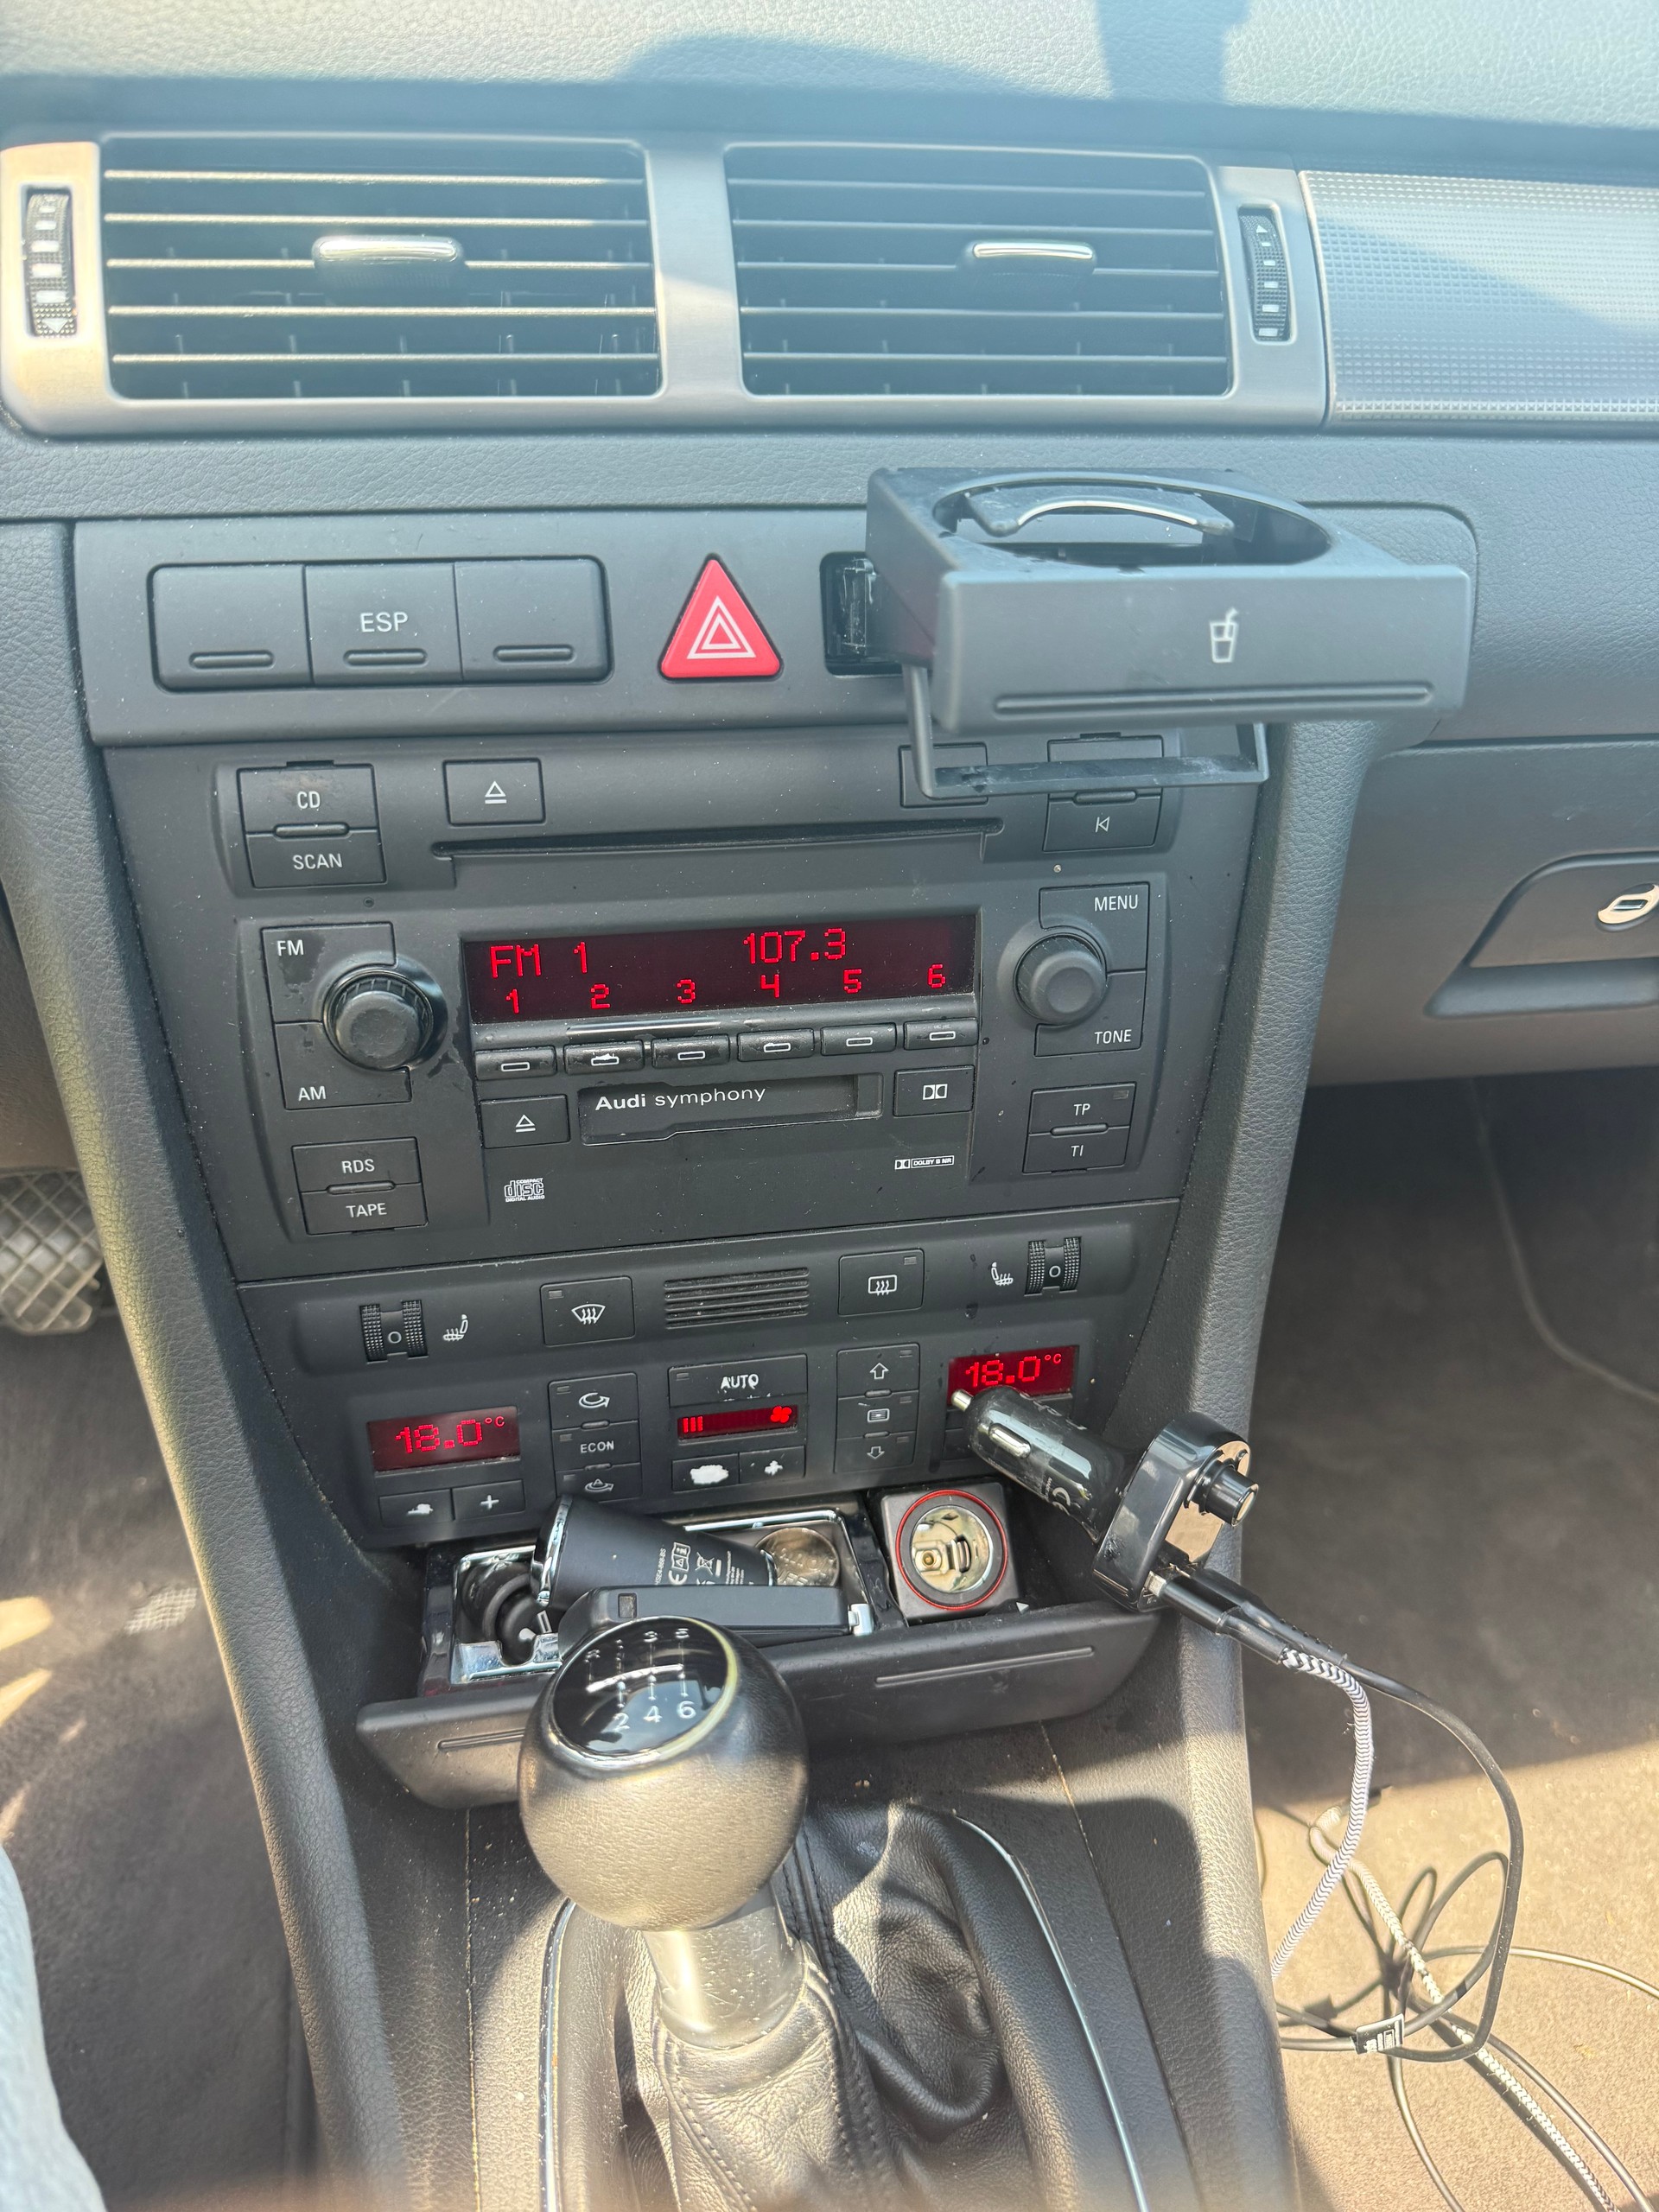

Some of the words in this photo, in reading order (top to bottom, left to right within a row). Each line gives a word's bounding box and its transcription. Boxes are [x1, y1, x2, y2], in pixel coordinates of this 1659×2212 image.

[359, 611, 409, 632] ESP
[296, 791, 321, 810] CD
[292, 853, 343, 870] SCAN
[1094, 894, 1138, 912] MENU
[276, 939, 304, 957] FM
[490, 944, 542, 979] FM
[573, 942, 588, 974] 1
[743, 928, 846, 964] 107.3
[505, 988, 519, 1014] 1
[590, 983, 610, 1009] 2
[676, 979, 696, 1004] 3
[760, 974, 780, 998] 4
[843, 969, 861, 994] 5
[927, 963, 946, 988] 6
[1094, 1029, 1132, 1045] TONE
[298, 1085, 327, 1102] AM
[594, 1093, 646, 1111] Audi
[655, 1088, 766, 1109] symphony
[1073, 1103, 1090, 1116] TP
[341, 1158, 375, 1174] RDS
[346, 1201, 387, 1218] TAPE
[720, 1373, 760, 1389] AUTO
[580, 1440, 614, 1453] ECON
[613, 1713, 631, 1732] 2
[643, 1706, 663, 1723] 4
[677, 1700, 696, 1719] 6
